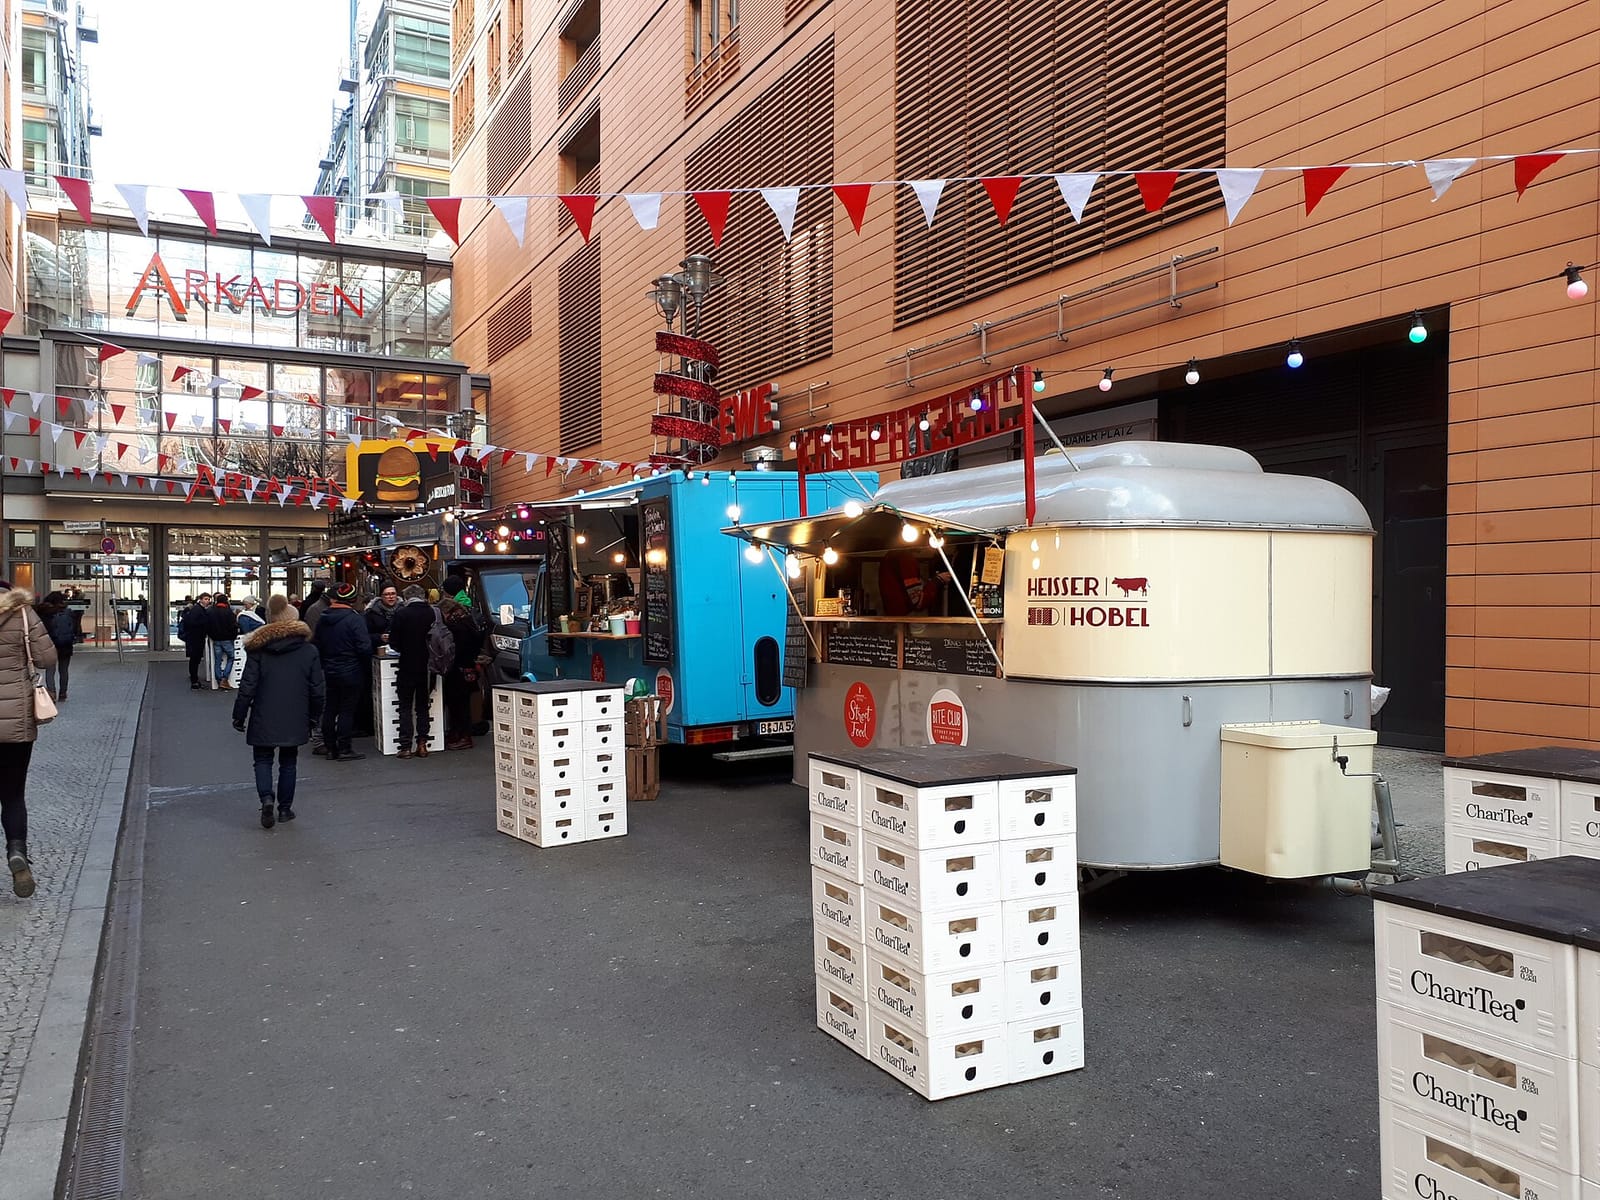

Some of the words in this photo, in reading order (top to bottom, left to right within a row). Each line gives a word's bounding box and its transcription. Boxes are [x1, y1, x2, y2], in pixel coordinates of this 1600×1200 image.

[126, 251, 364, 319] ARKADEN
[711, 382, 780, 446] EWE
[1042, 431, 1099, 450] POSDAMER
[1100, 425, 1134, 440] PLATZ
[1027, 576, 1100, 597] HEISSER
[1070, 606, 1150, 627] HOBEL
[848, 699, 873, 724] Street
[932, 709, 946, 725] BITE
[947, 709, 961, 726] CLUB
[850, 721, 870, 741] Food
[818, 792, 848, 813] ChariTea
[1466, 803, 1533, 826] ChariTea
[871, 809, 906, 834] ChariTea
[819, 846, 849, 869] ChariTea
[873, 868, 908, 895] ChariTea
[821, 902, 851, 927] ChariTea
[875, 926, 910, 956] ChariTea
[823, 957, 854, 986] ChariTea
[877, 986, 913, 1018] ChariTea
[1410, 969, 1526, 1024] ChariTea
[826, 1010, 856, 1041] ChariTea
[880, 1044, 916, 1078] ChariTea
[1412, 1071, 1528, 1134] ChariTea
